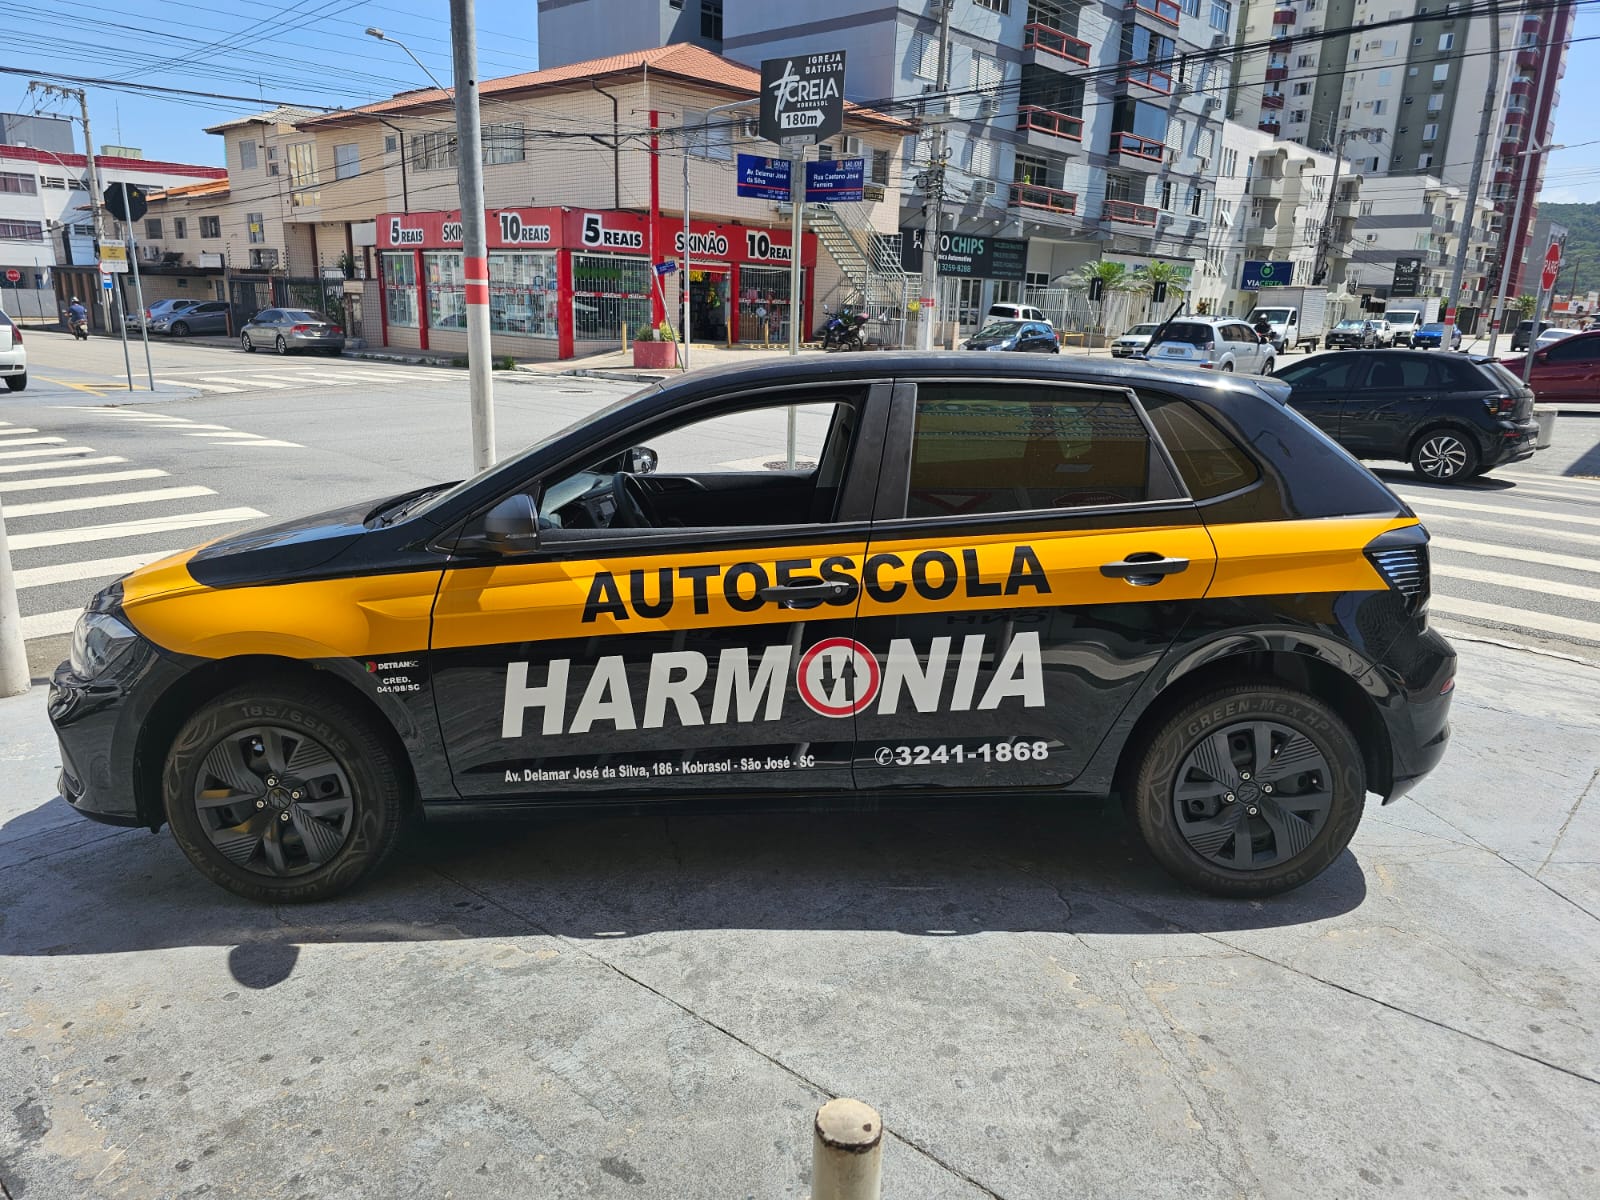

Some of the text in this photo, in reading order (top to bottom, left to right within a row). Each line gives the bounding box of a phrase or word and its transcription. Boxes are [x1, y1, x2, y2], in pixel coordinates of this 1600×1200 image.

[805, 63, 843, 74] BATISTA
[808, 53, 841, 65] IGREJA
[785, 77, 839, 102] CREIA
[785, 113, 818, 127] 180m
[391, 219, 423, 243] 5 REAIS
[501, 214, 550, 242] 10 REAIS
[584, 217, 642, 248] 5 REAIS
[675, 230, 728, 255] SKINÃO
[747, 234, 770, 258] 10
[951, 236, 984, 255] CHIPS
[1543, 259, 1559, 274] PARE
[581, 545, 1052, 623] AUTOESCOLA
[382, 676, 411, 685] CRED.
[894, 741, 1050, 766] 3241-1868
[504, 768, 522, 783] Av.
[524, 766, 570, 782] Delamar
[572, 764, 600, 780] José
[602, 764, 616, 779] da
[618, 763, 650, 780] Silva,
[652, 761, 673, 777] 186
[682, 758, 732, 775] Kobrasol
[741, 756, 762, 772] São
[764, 755, 791, 771] José
[799, 754, 816, 769] SC
